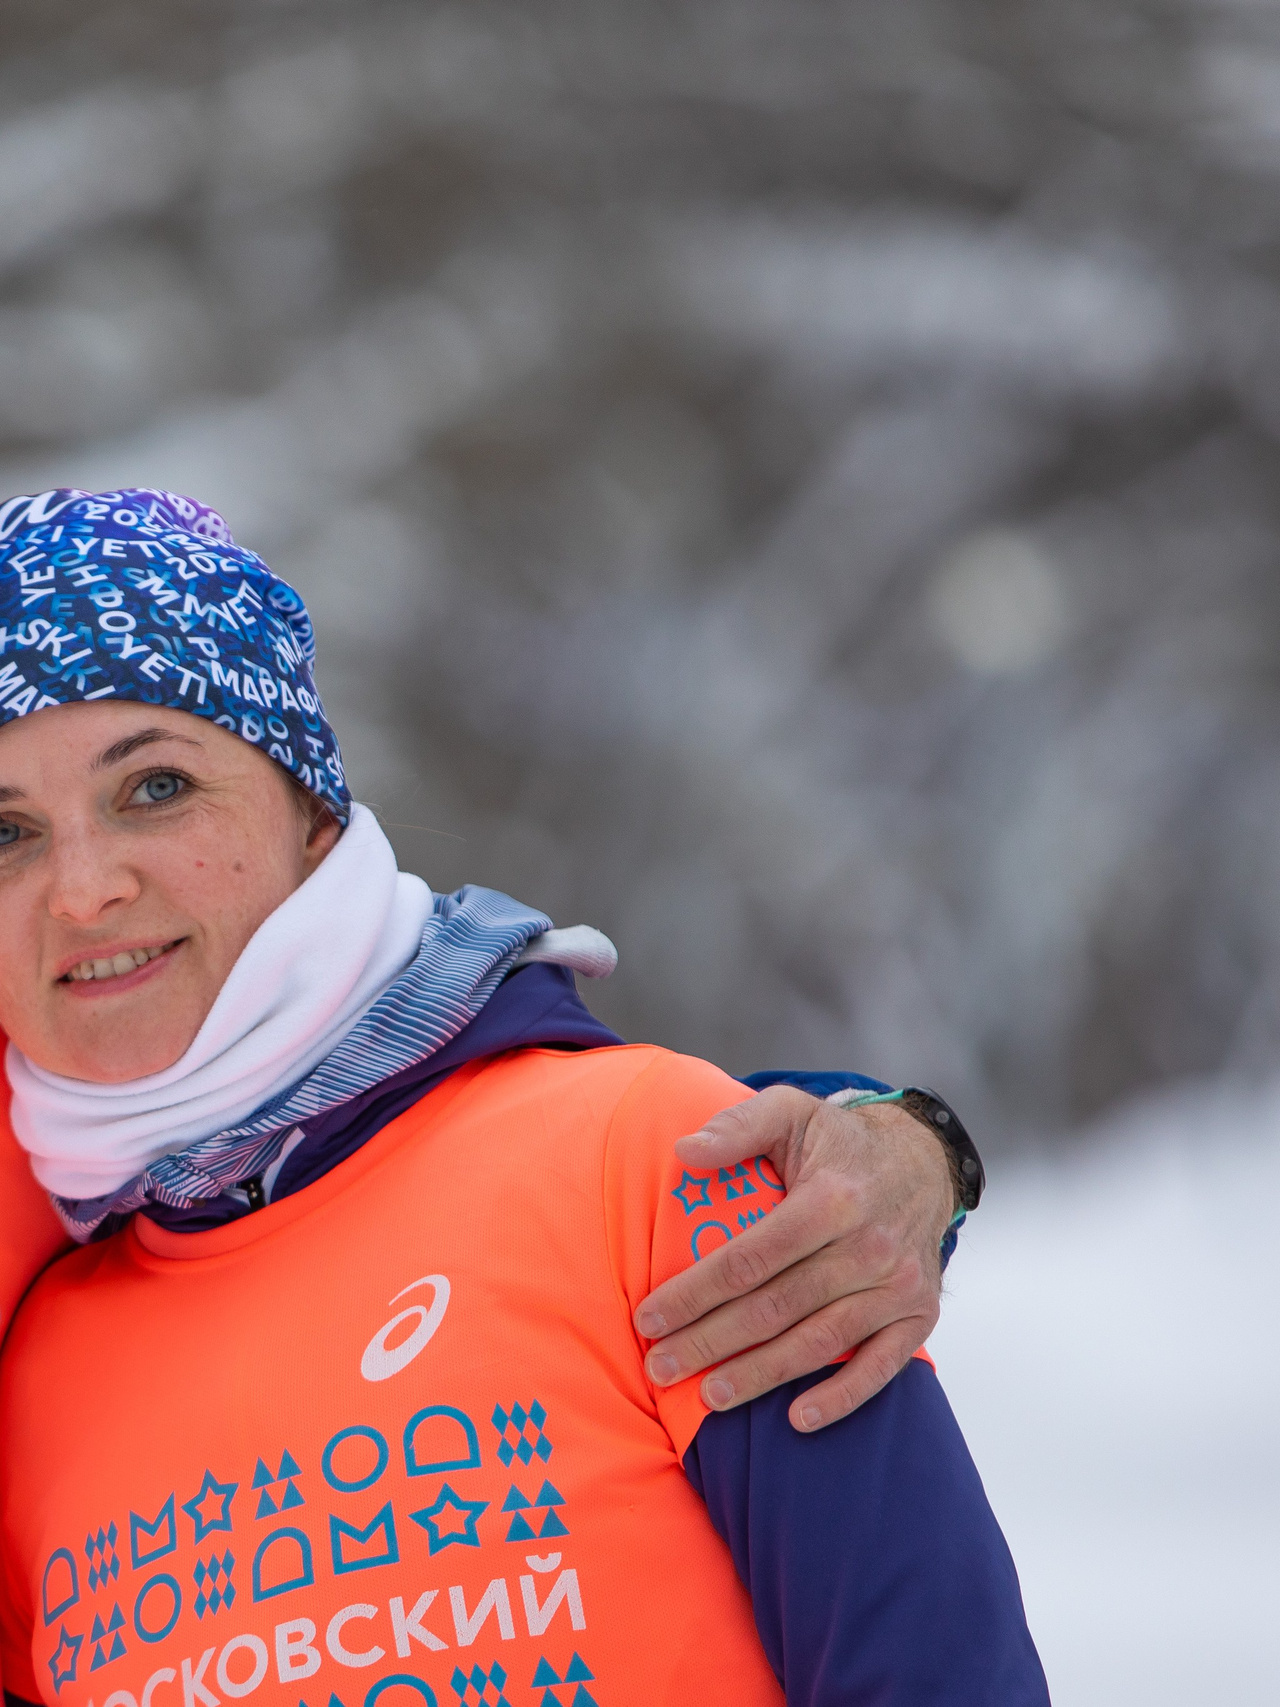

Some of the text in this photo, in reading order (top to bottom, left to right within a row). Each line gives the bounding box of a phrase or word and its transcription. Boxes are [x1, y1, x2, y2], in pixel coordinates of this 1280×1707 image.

[7, 545, 57, 608] YETI
[71, 537, 174, 560] YETI
[209, 579, 265, 631] YETI
[17, 618, 93, 666] SKI
[118, 632, 208, 705] YETI
[87, 1551, 587, 1707] СКОВСКИЙ
